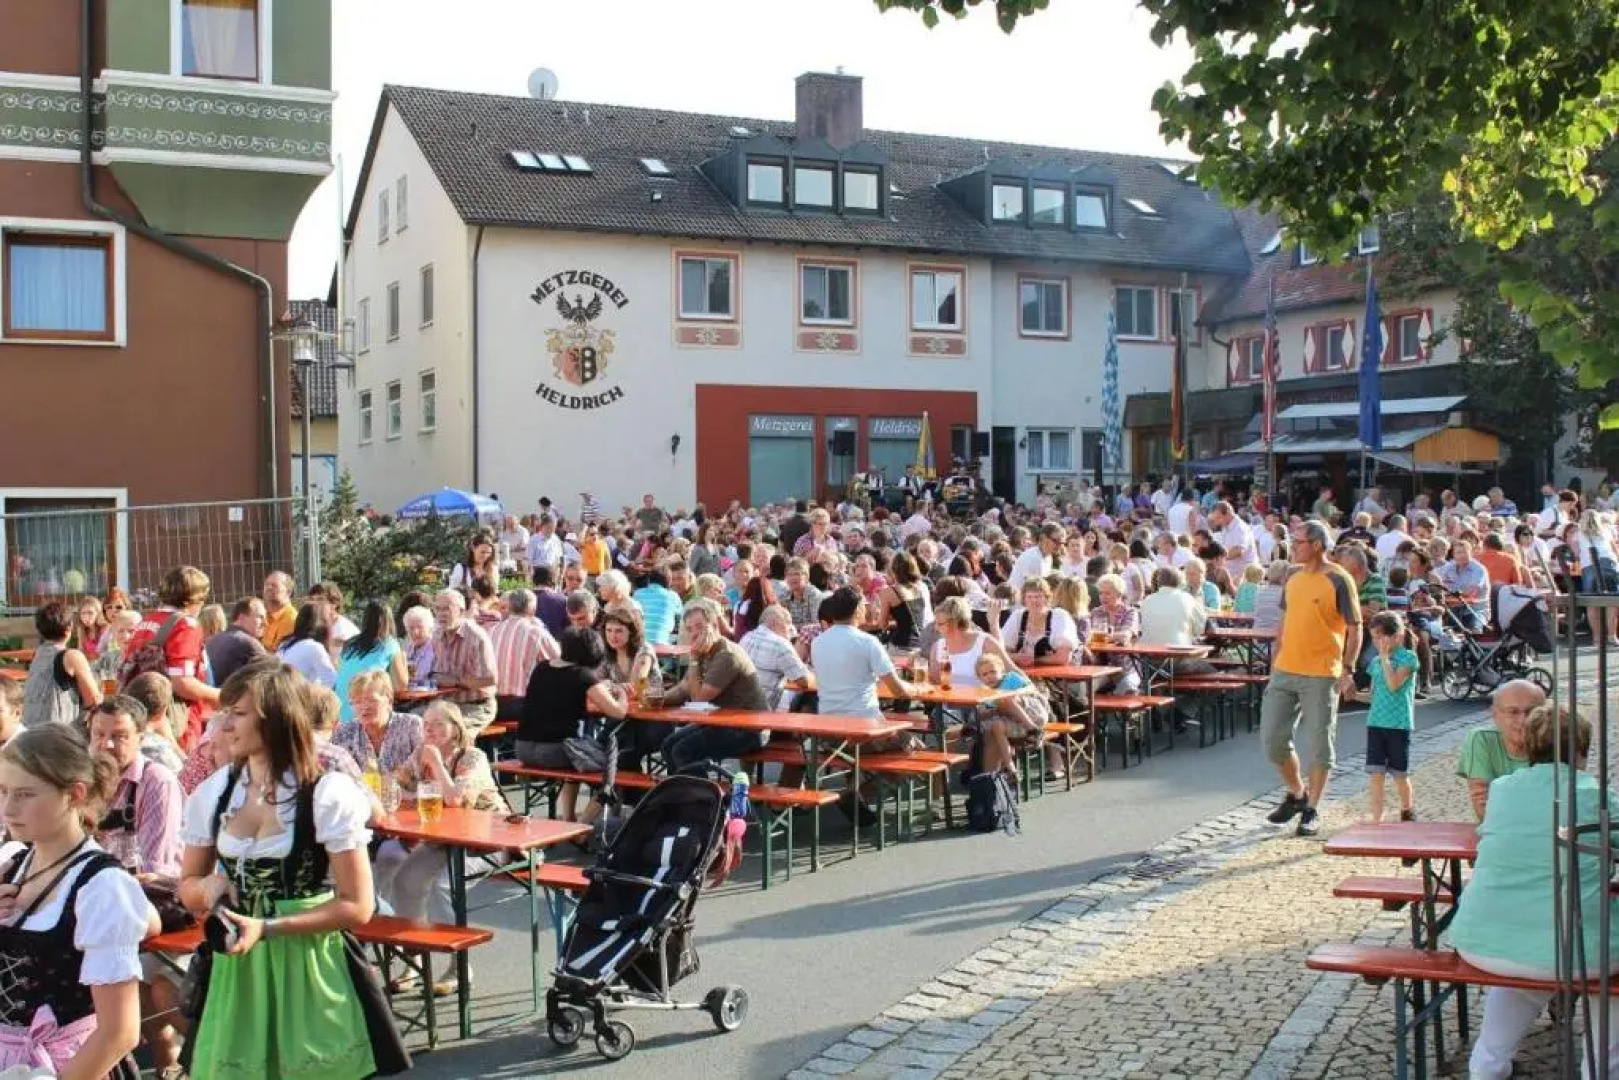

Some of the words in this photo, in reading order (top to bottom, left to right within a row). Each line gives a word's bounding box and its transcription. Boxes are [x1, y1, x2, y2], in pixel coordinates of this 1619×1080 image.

[530, 269, 630, 310] METZGEREI
[535, 382, 624, 410] HELDRICH
[752, 416, 813, 434] Metzgerei
